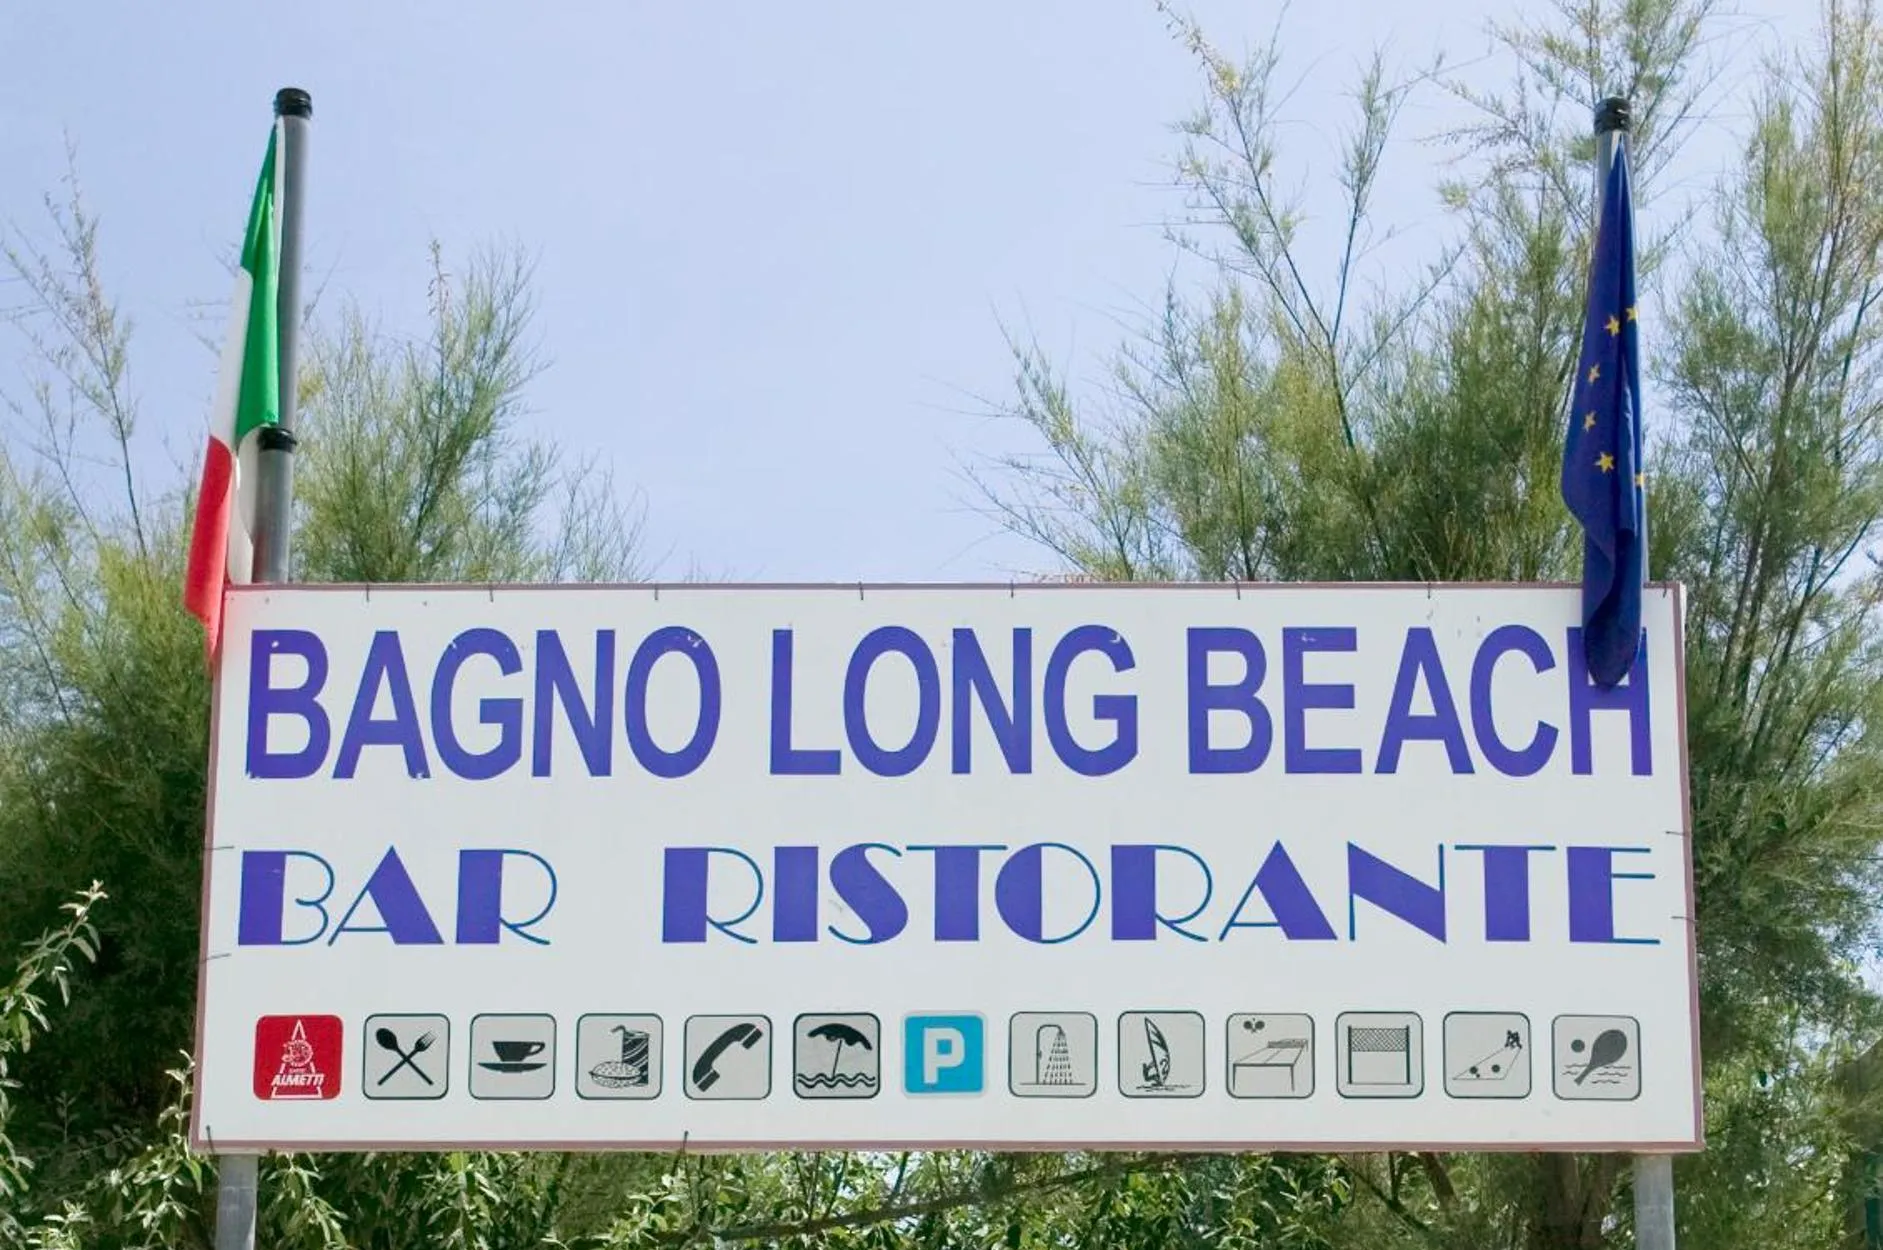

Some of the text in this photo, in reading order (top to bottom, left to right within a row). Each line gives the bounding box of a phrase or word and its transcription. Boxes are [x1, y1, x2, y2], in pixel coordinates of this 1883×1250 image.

[247, 624, 1653, 779] BAGNO LONG BEACH
[238, 841, 1661, 945] BAR RISTORANTE
[924, 1027, 965, 1084] P
